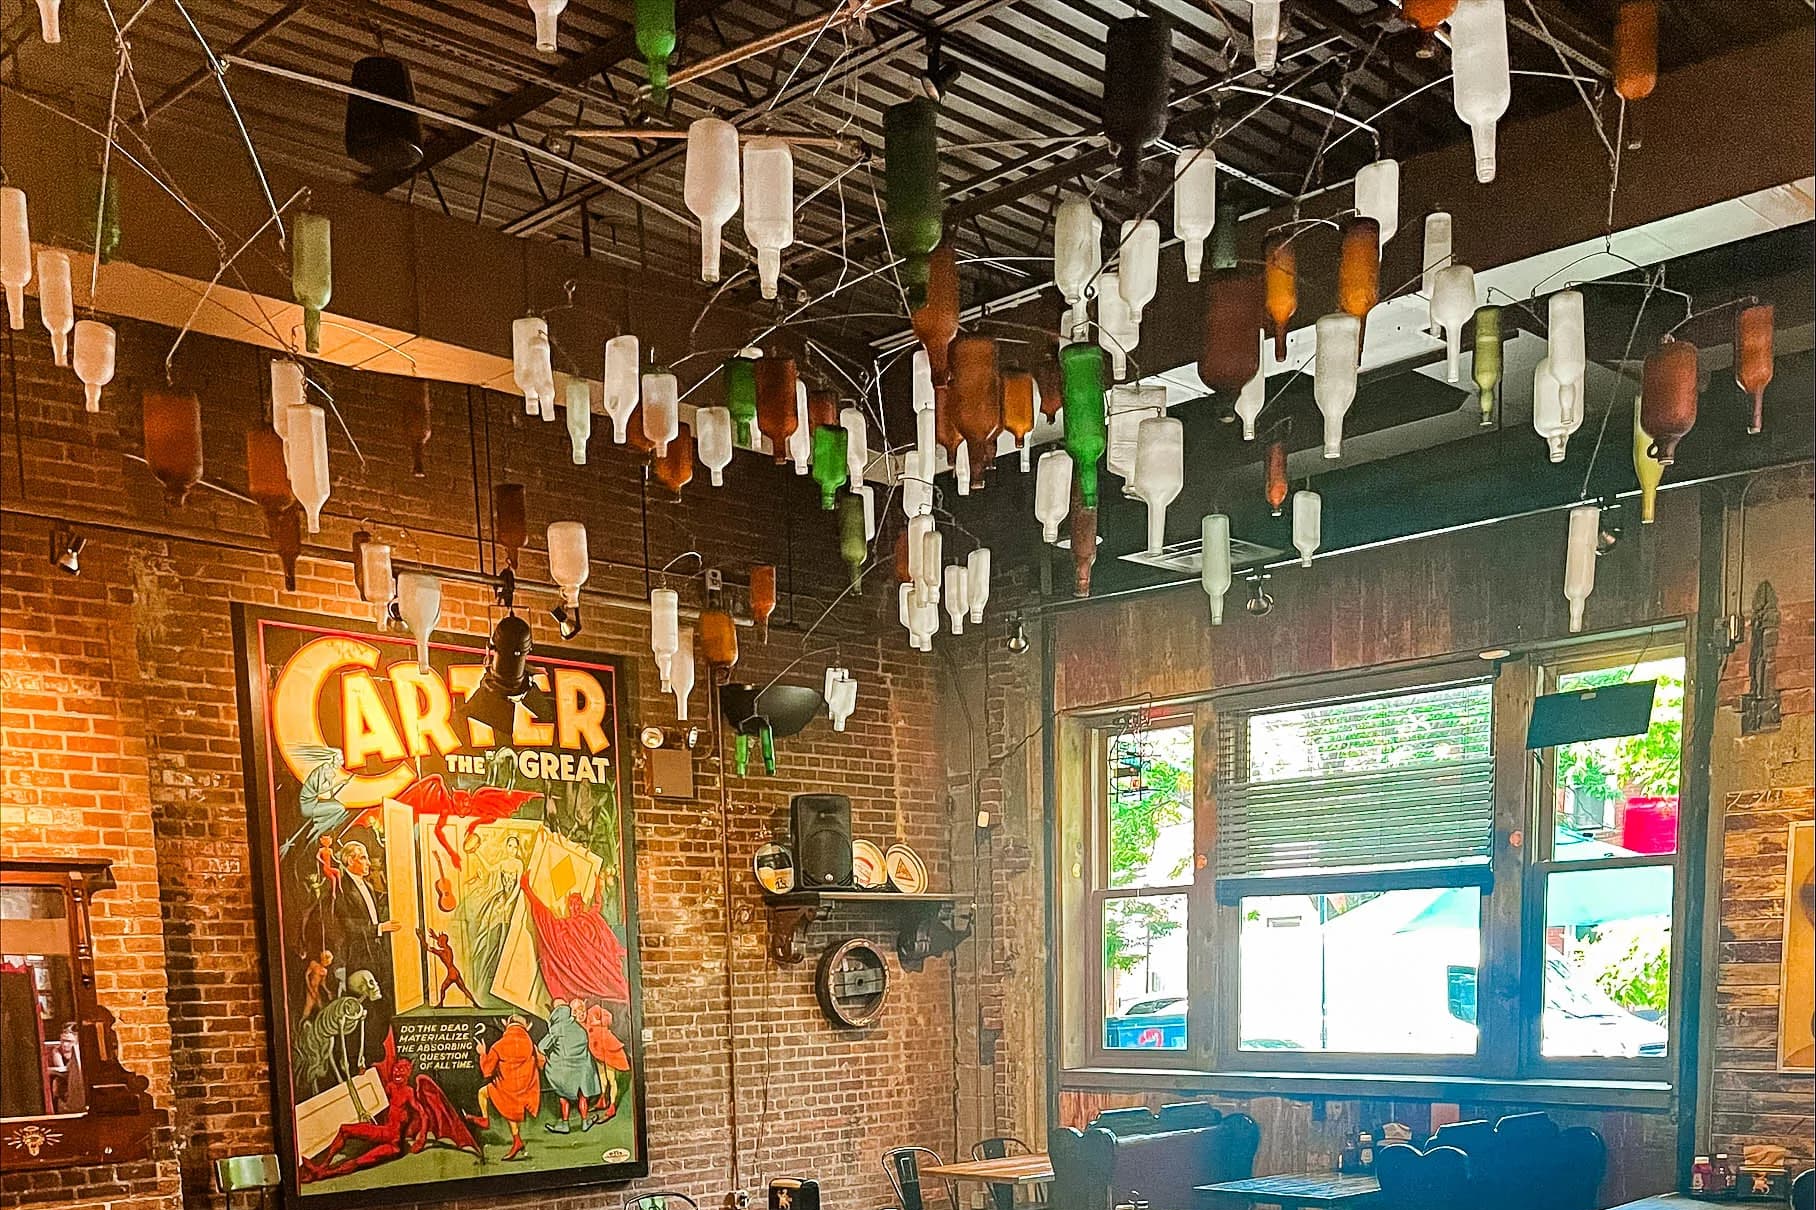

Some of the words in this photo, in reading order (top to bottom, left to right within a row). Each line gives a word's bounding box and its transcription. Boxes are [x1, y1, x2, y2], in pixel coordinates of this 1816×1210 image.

[445, 754, 486, 775] THE
[518, 750, 610, 784] GREAT
[400, 1025, 415, 1033] DO
[417, 1024, 437, 1033] THE
[440, 1023, 469, 1032] DEAD
[398, 1032, 470, 1043] MATERIALIZE
[396, 1044, 415, 1053] THE
[416, 1042, 473, 1053] ABSORBING
[420, 1051, 469, 1062] QUESTION
[420, 1061, 433, 1070] OF
[433, 1061, 450, 1070] ALL
